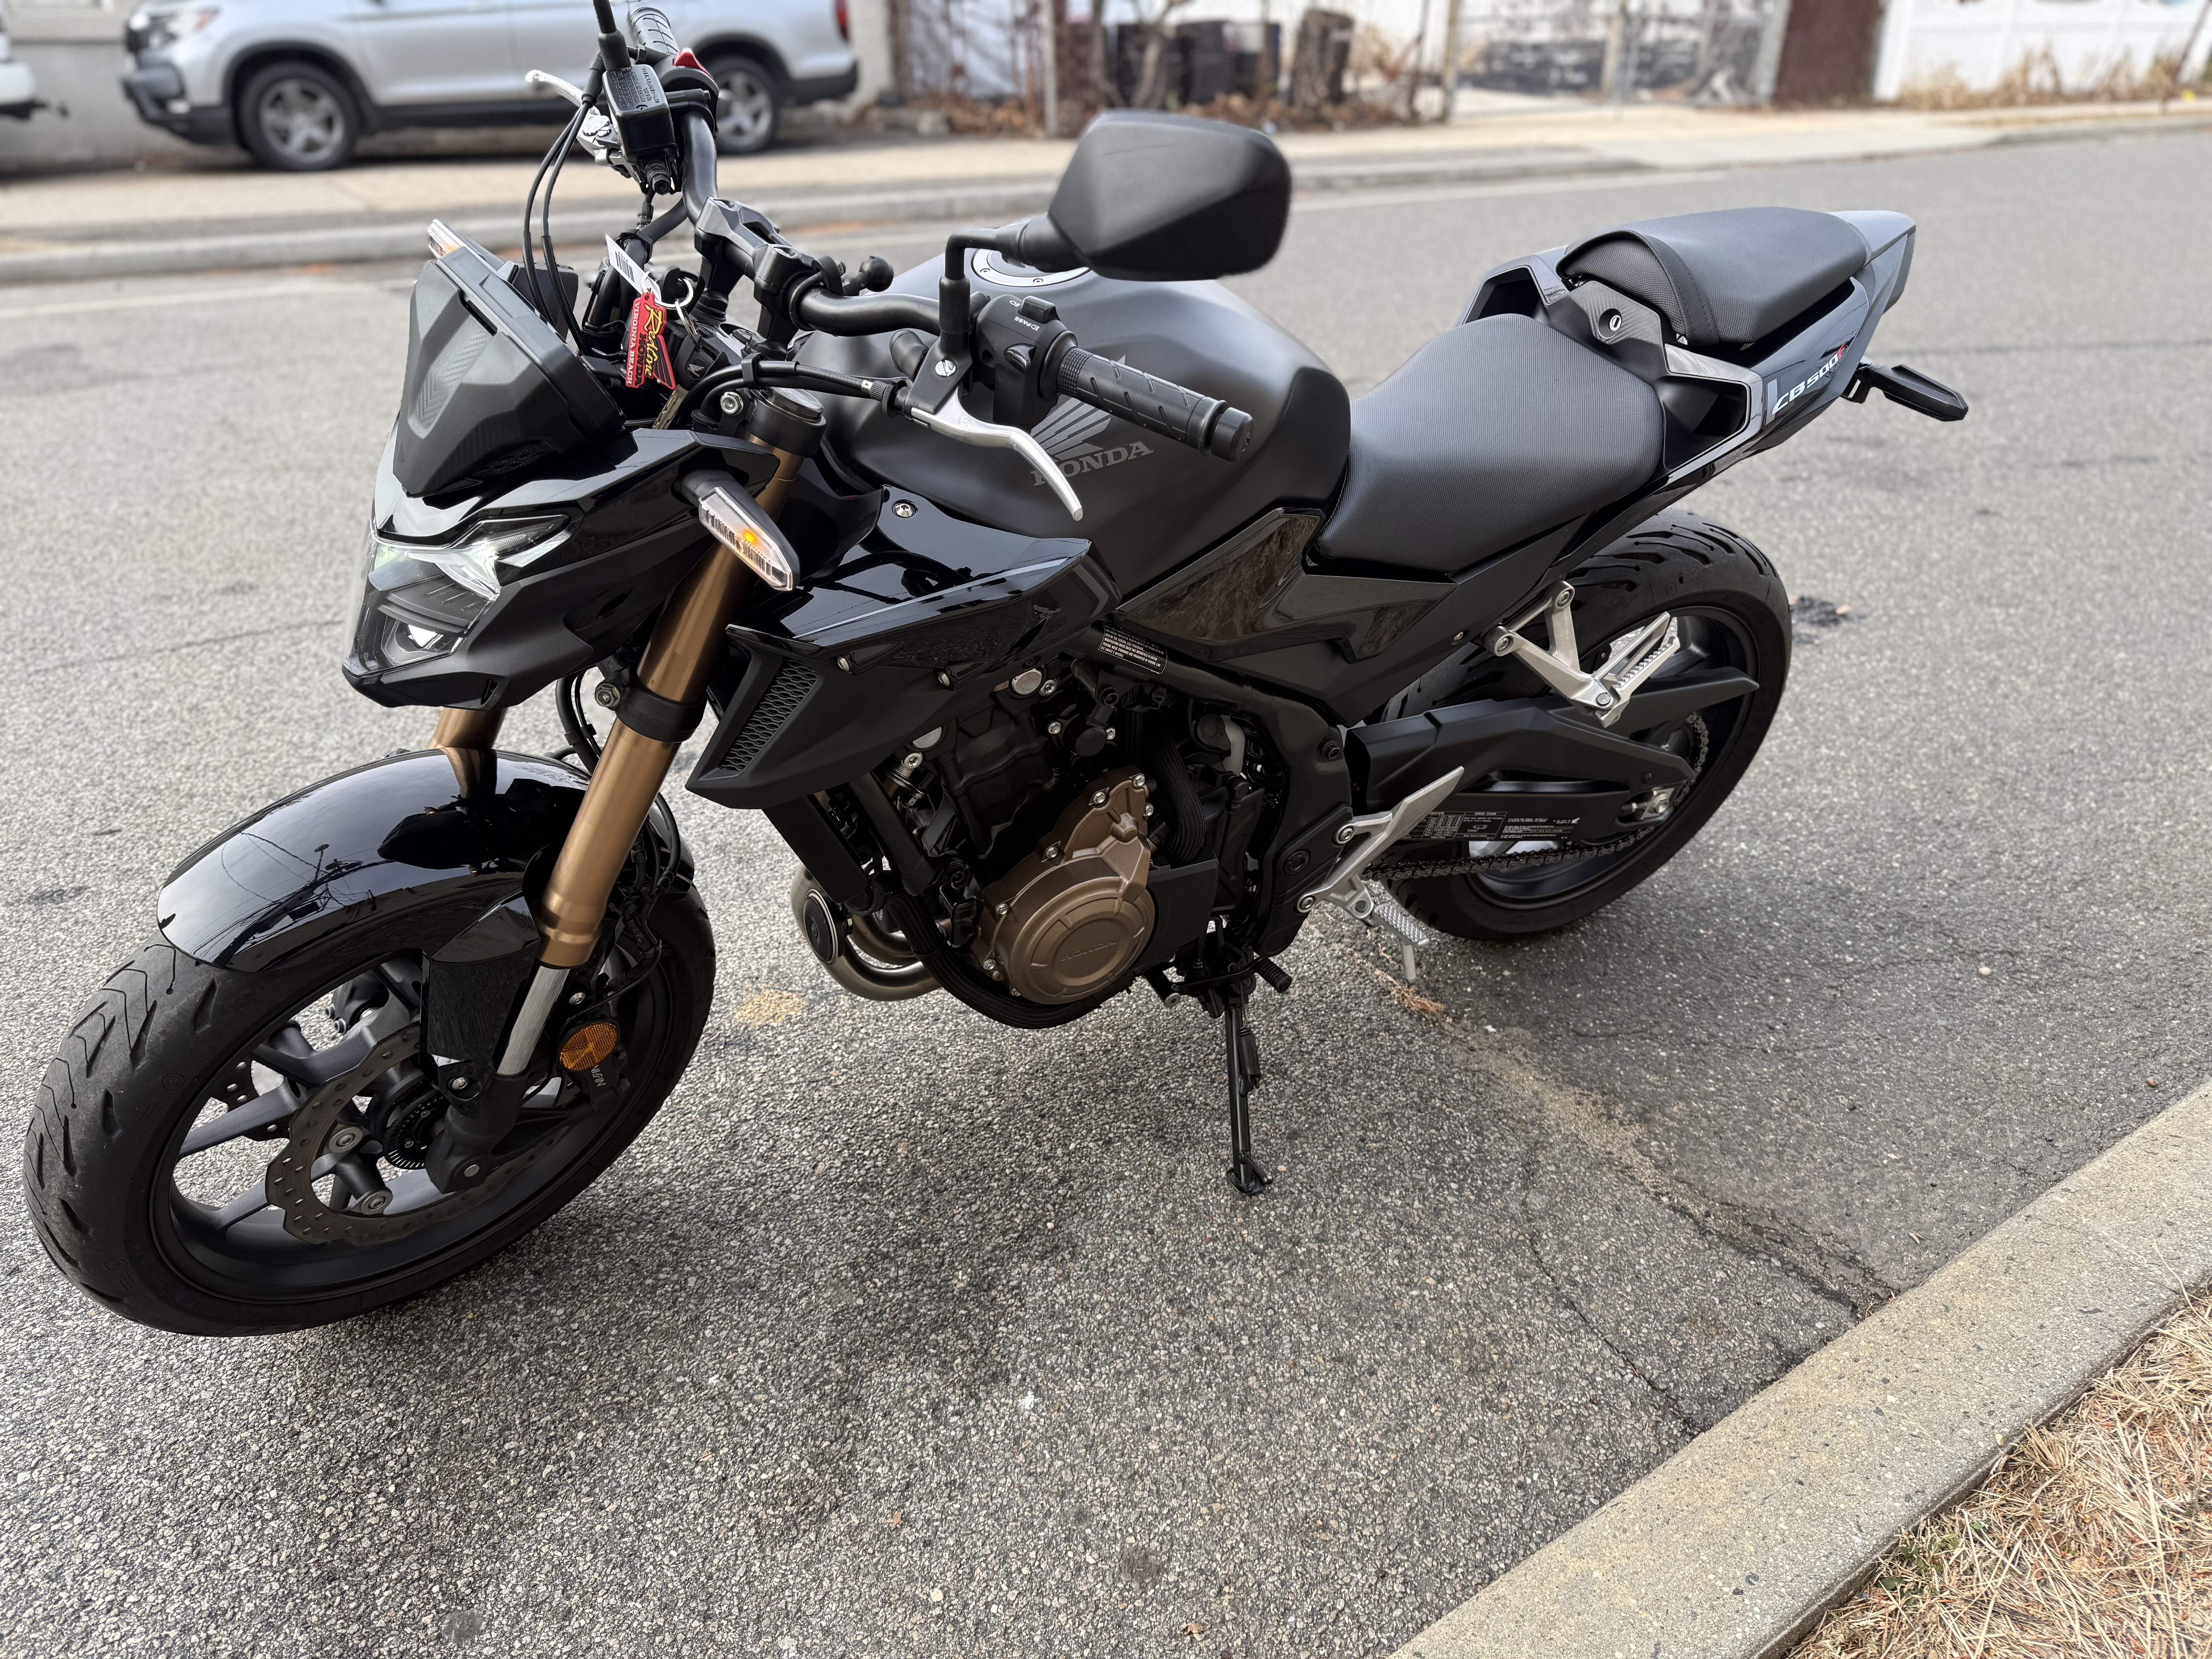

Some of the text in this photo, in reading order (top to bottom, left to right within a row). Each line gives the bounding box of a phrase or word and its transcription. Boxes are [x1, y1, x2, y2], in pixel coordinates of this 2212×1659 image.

[627, 302, 640, 385] VIRGINIA BEACH
[635, 333, 646, 386] HONDA
[643, 303, 662, 377] Redline
[1060, 939, 1116, 961] HONDA
